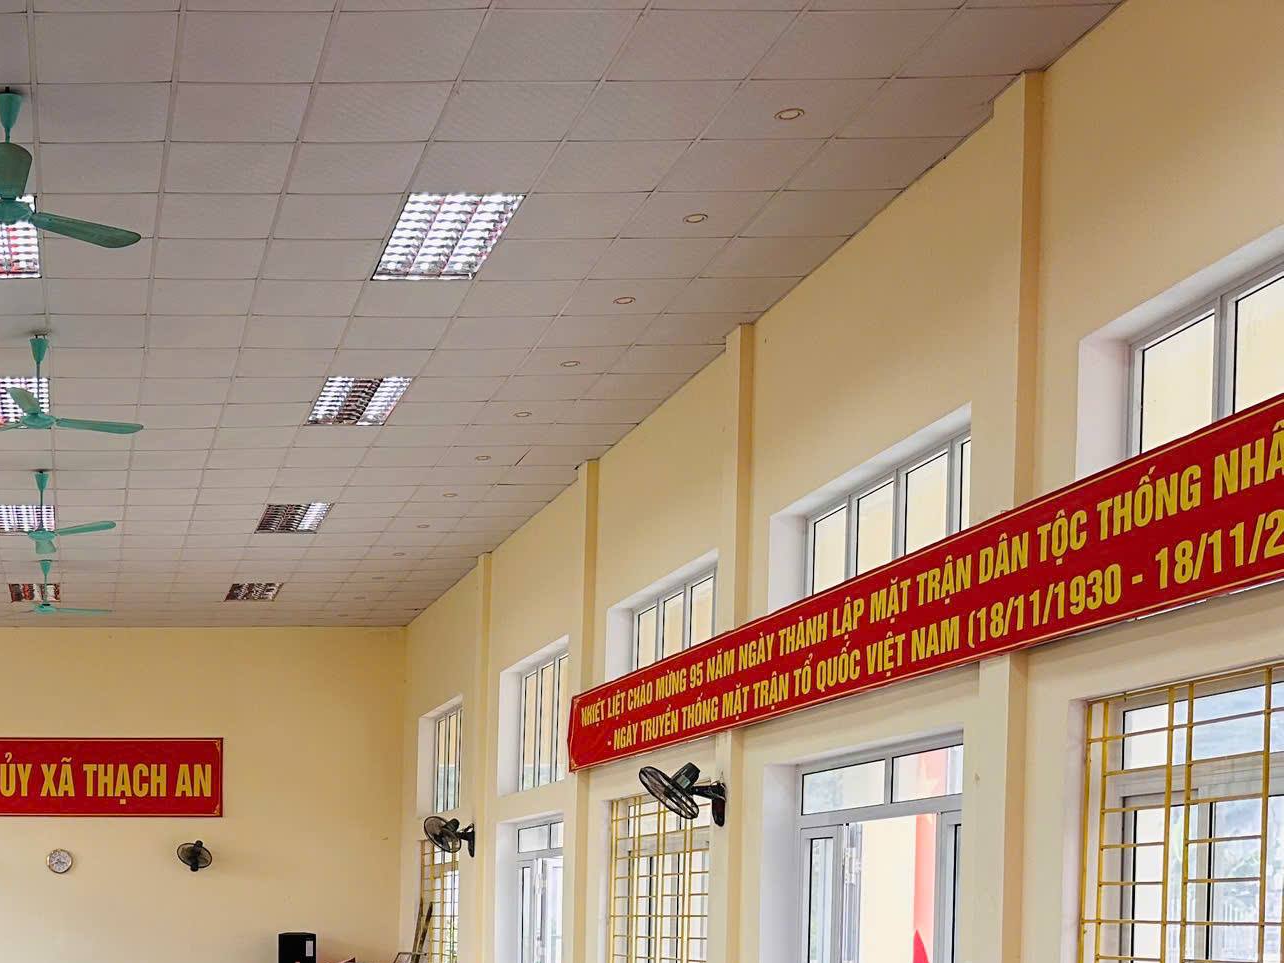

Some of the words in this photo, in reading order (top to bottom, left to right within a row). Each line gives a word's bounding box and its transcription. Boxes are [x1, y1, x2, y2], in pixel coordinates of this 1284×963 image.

[607, 689, 625, 720] LIỆT
[627, 686, 653, 713] CHÀO
[656, 672, 687, 706] MỪNG
[690, 665, 704, 689] 95
[706, 649, 735, 680] NĂM
[738, 632, 776, 671] NGÀY
[778, 611, 828, 657] THÀNH
[832, 596, 865, 639] LẬP
[869, 576, 912, 624] MẶT
[916, 555, 972, 606] TRẬN
[978, 532, 1029, 586] DÂN
[1037, 508, 1087, 565] TỘC
[1096, 465, 1202, 542] THỐNG
[614, 722, 637, 751] NGÀY
[641, 701, 679, 740] TRUYỀN
[682, 691, 719, 730] THỐNG
[722, 681, 750, 721] MẶT
[753, 669, 790, 711] TRẬN
[793, 652, 814, 697] TỔ
[816, 637, 861, 692] QUỐC
[866, 632, 906, 677] VIỆT
[911, 614, 960, 663] NAM
[968, 563, 1122, 649] (18/11/1930
[1132, 572, 1143, 585] -
[1155, 507, 1284, 590] 18/11/2
[0, 752, 33, 797] ỦY
[40, 756, 75, 797] XÃ
[82, 763, 167, 805] THẠCH
[175, 764, 212, 797] AN
